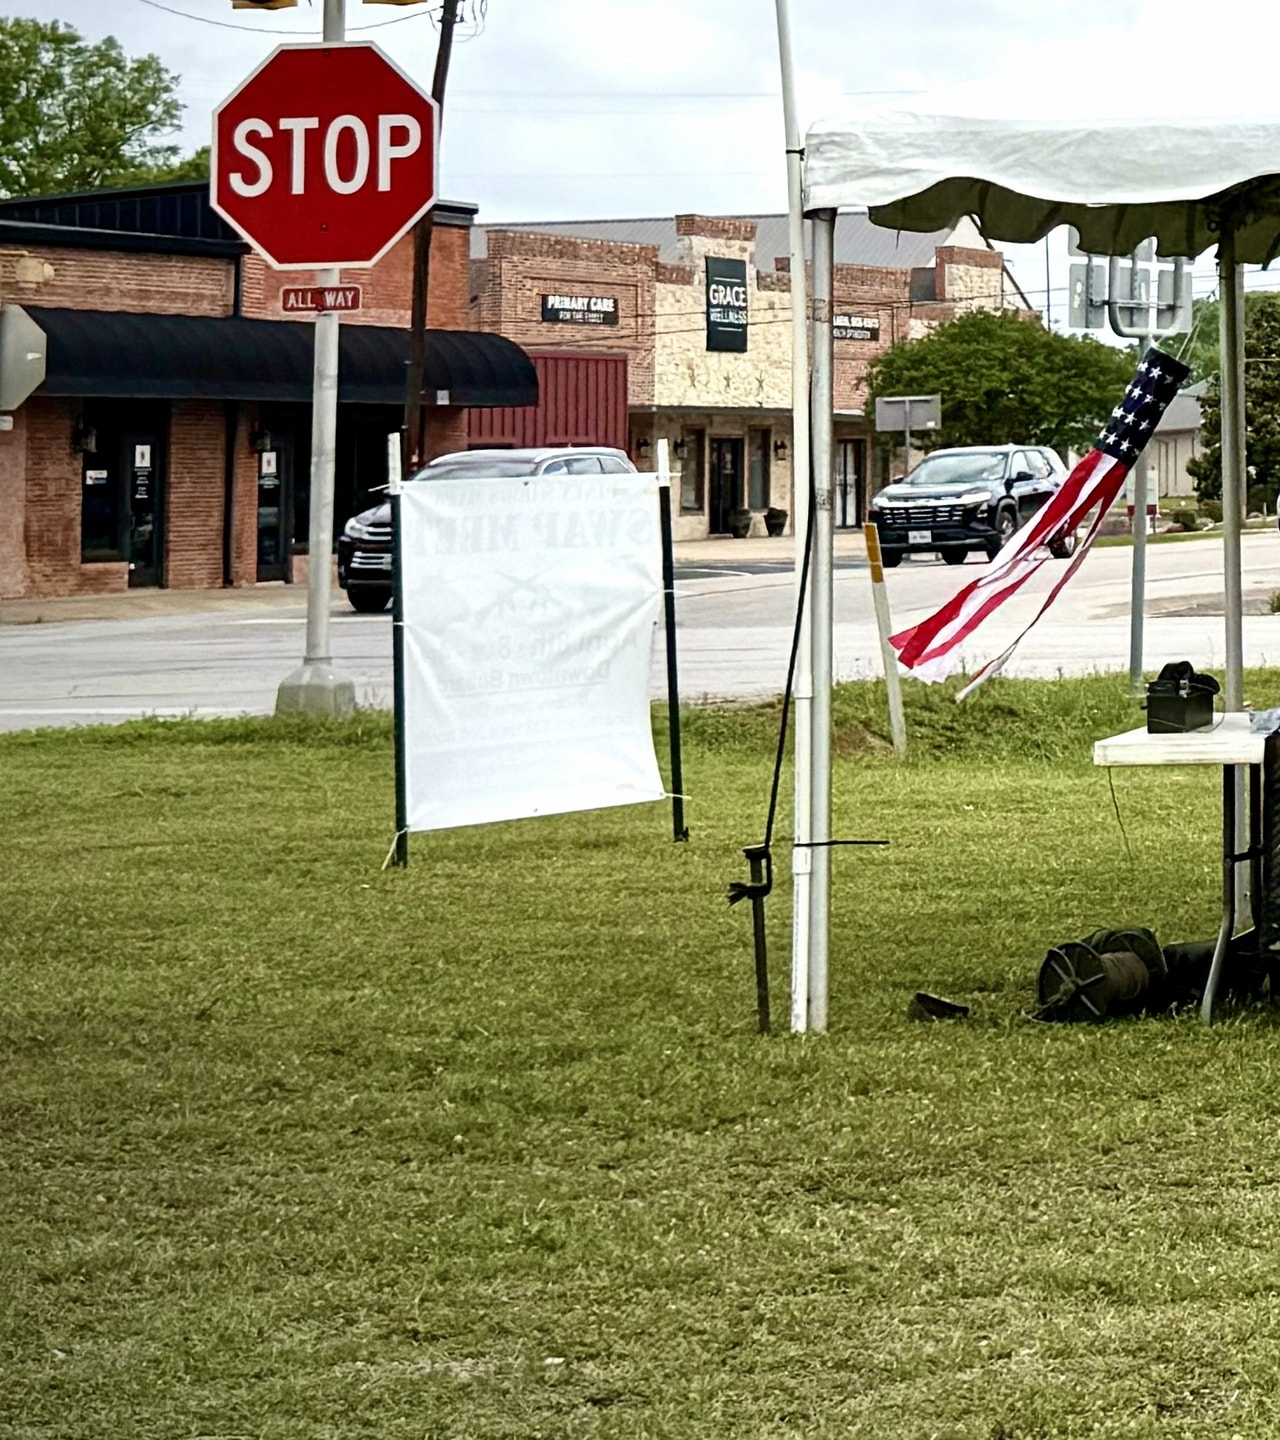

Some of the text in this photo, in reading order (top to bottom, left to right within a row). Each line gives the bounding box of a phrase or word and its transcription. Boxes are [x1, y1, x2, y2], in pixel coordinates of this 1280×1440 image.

[229, 114, 422, 197] STOP
[287, 291, 356, 309] ALL WAY
[547, 295, 615, 312] PRIMARY CARE
[709, 284, 747, 306] GRACE
